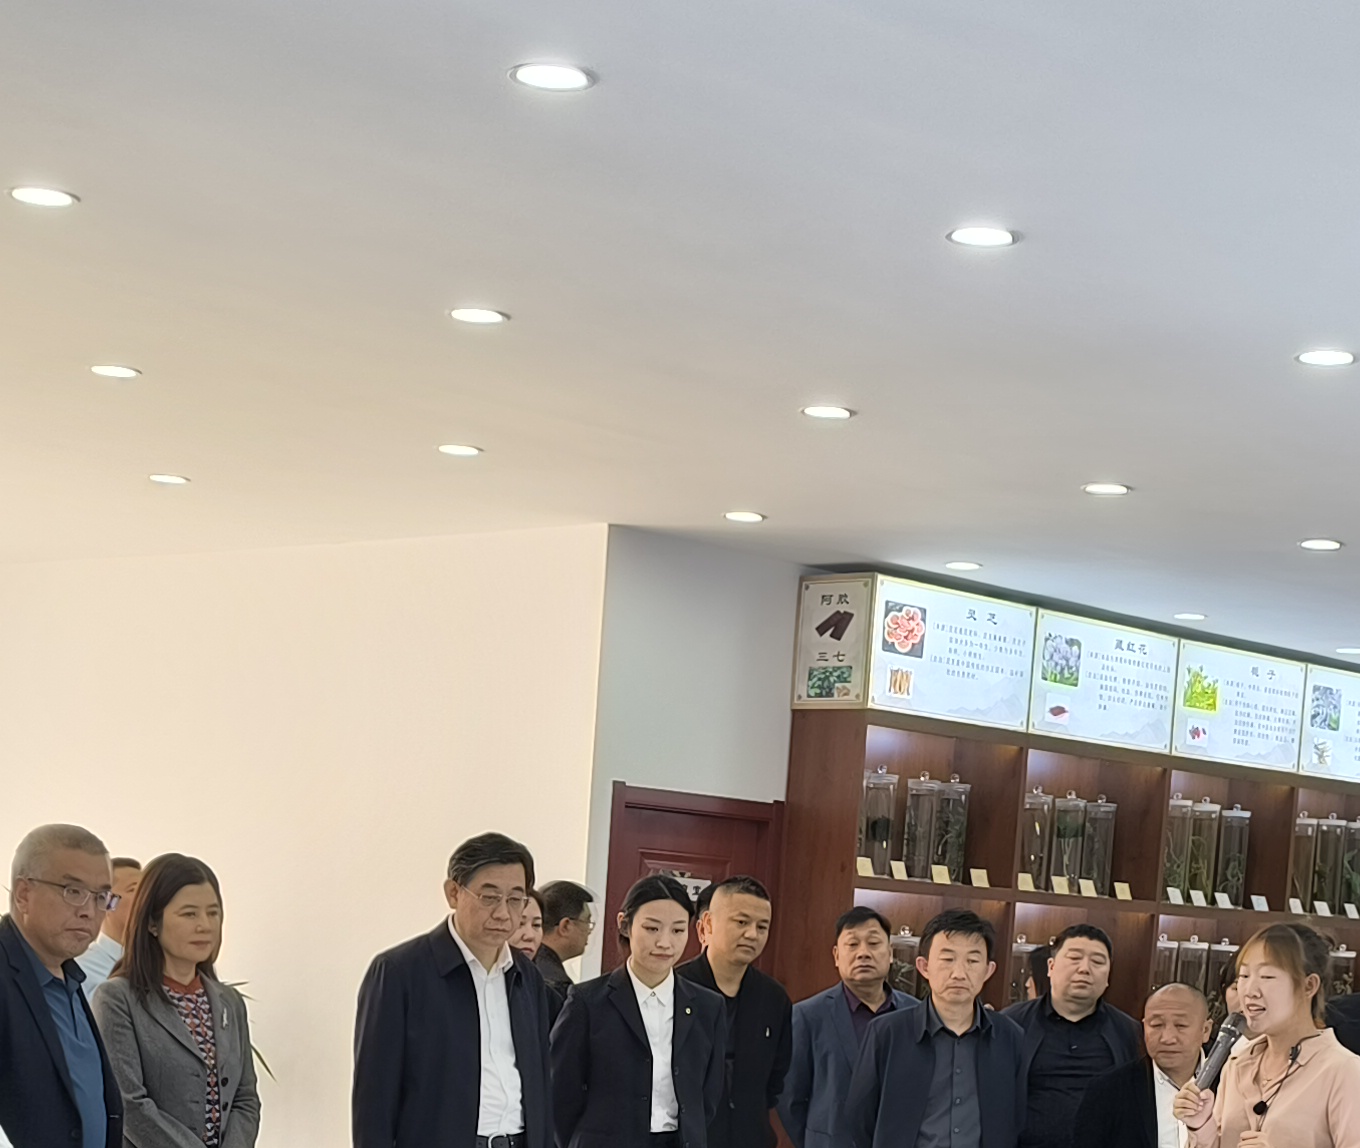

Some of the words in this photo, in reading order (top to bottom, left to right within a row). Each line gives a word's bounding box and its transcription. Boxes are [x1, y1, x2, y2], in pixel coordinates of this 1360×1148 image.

[821, 593, 849, 605] 阿胶
[966, 609, 998, 625] 灵芝
[816, 651, 845, 662] 三七
